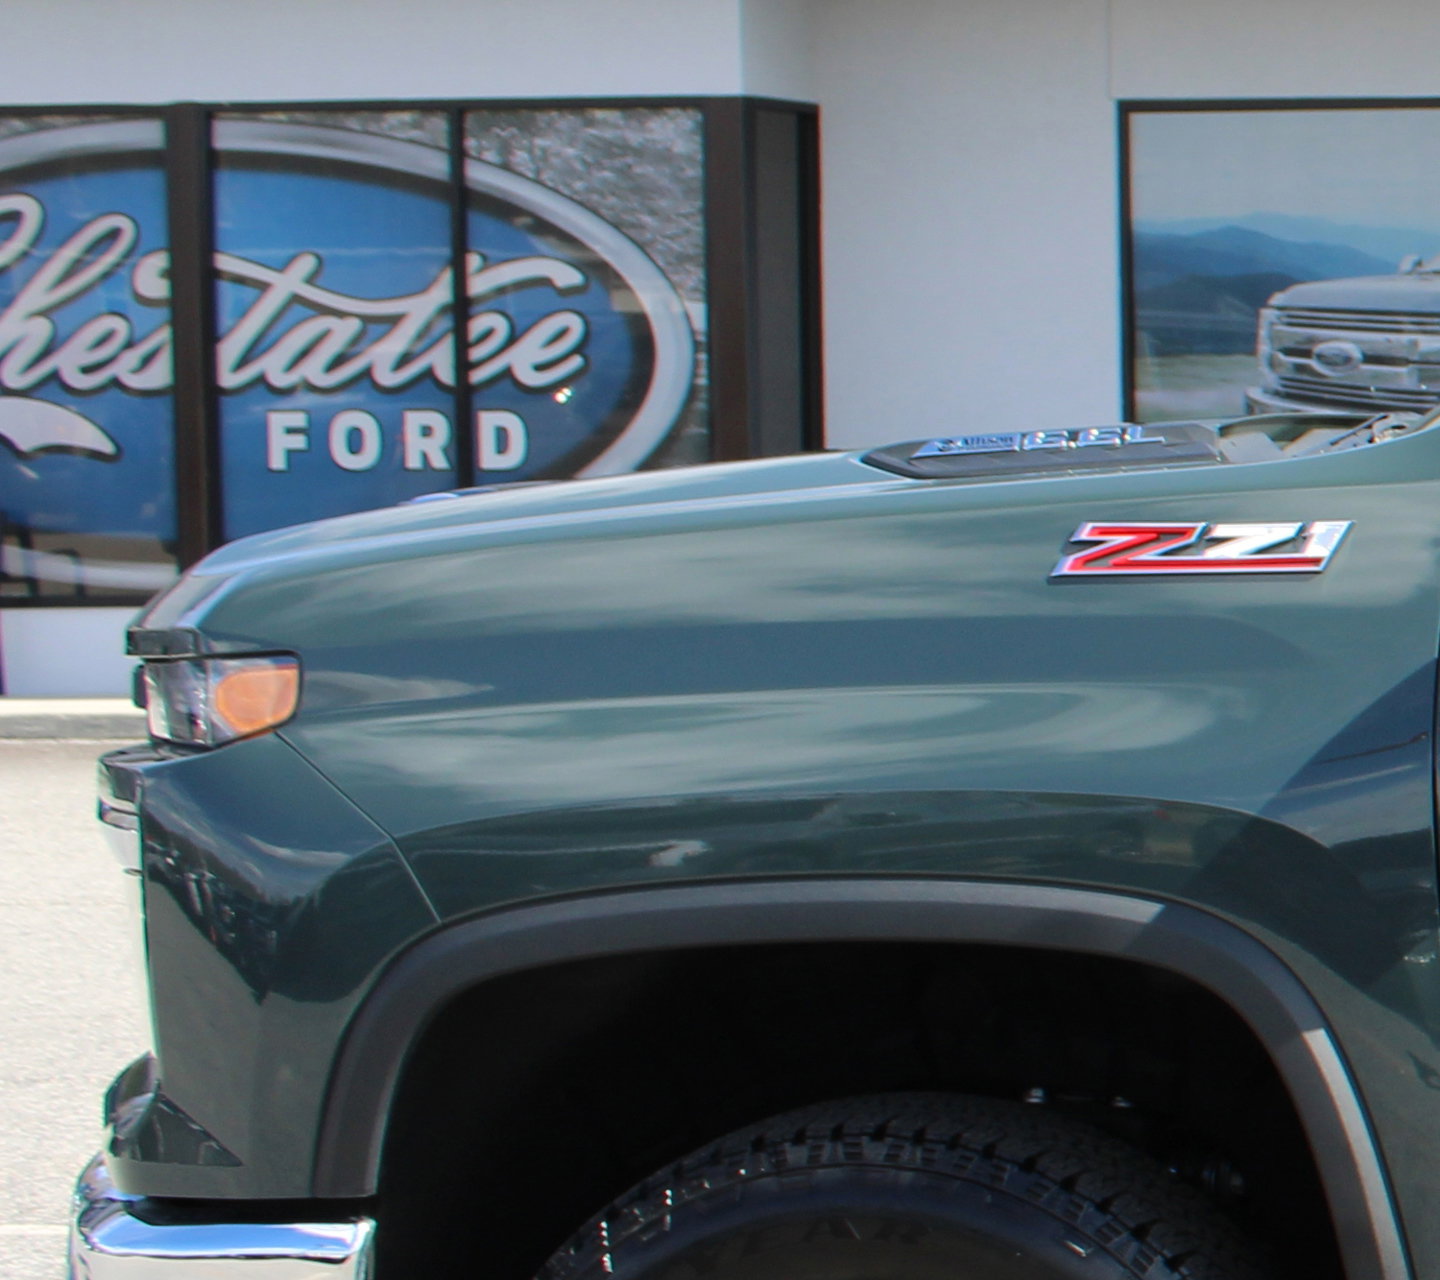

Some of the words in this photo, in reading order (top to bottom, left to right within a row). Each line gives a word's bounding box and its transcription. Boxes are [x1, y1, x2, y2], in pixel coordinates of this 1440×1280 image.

[0, 192, 589, 392] hestatee
[266, 409, 531, 473] FORD
[1048, 520, 1355, 577] Z71
